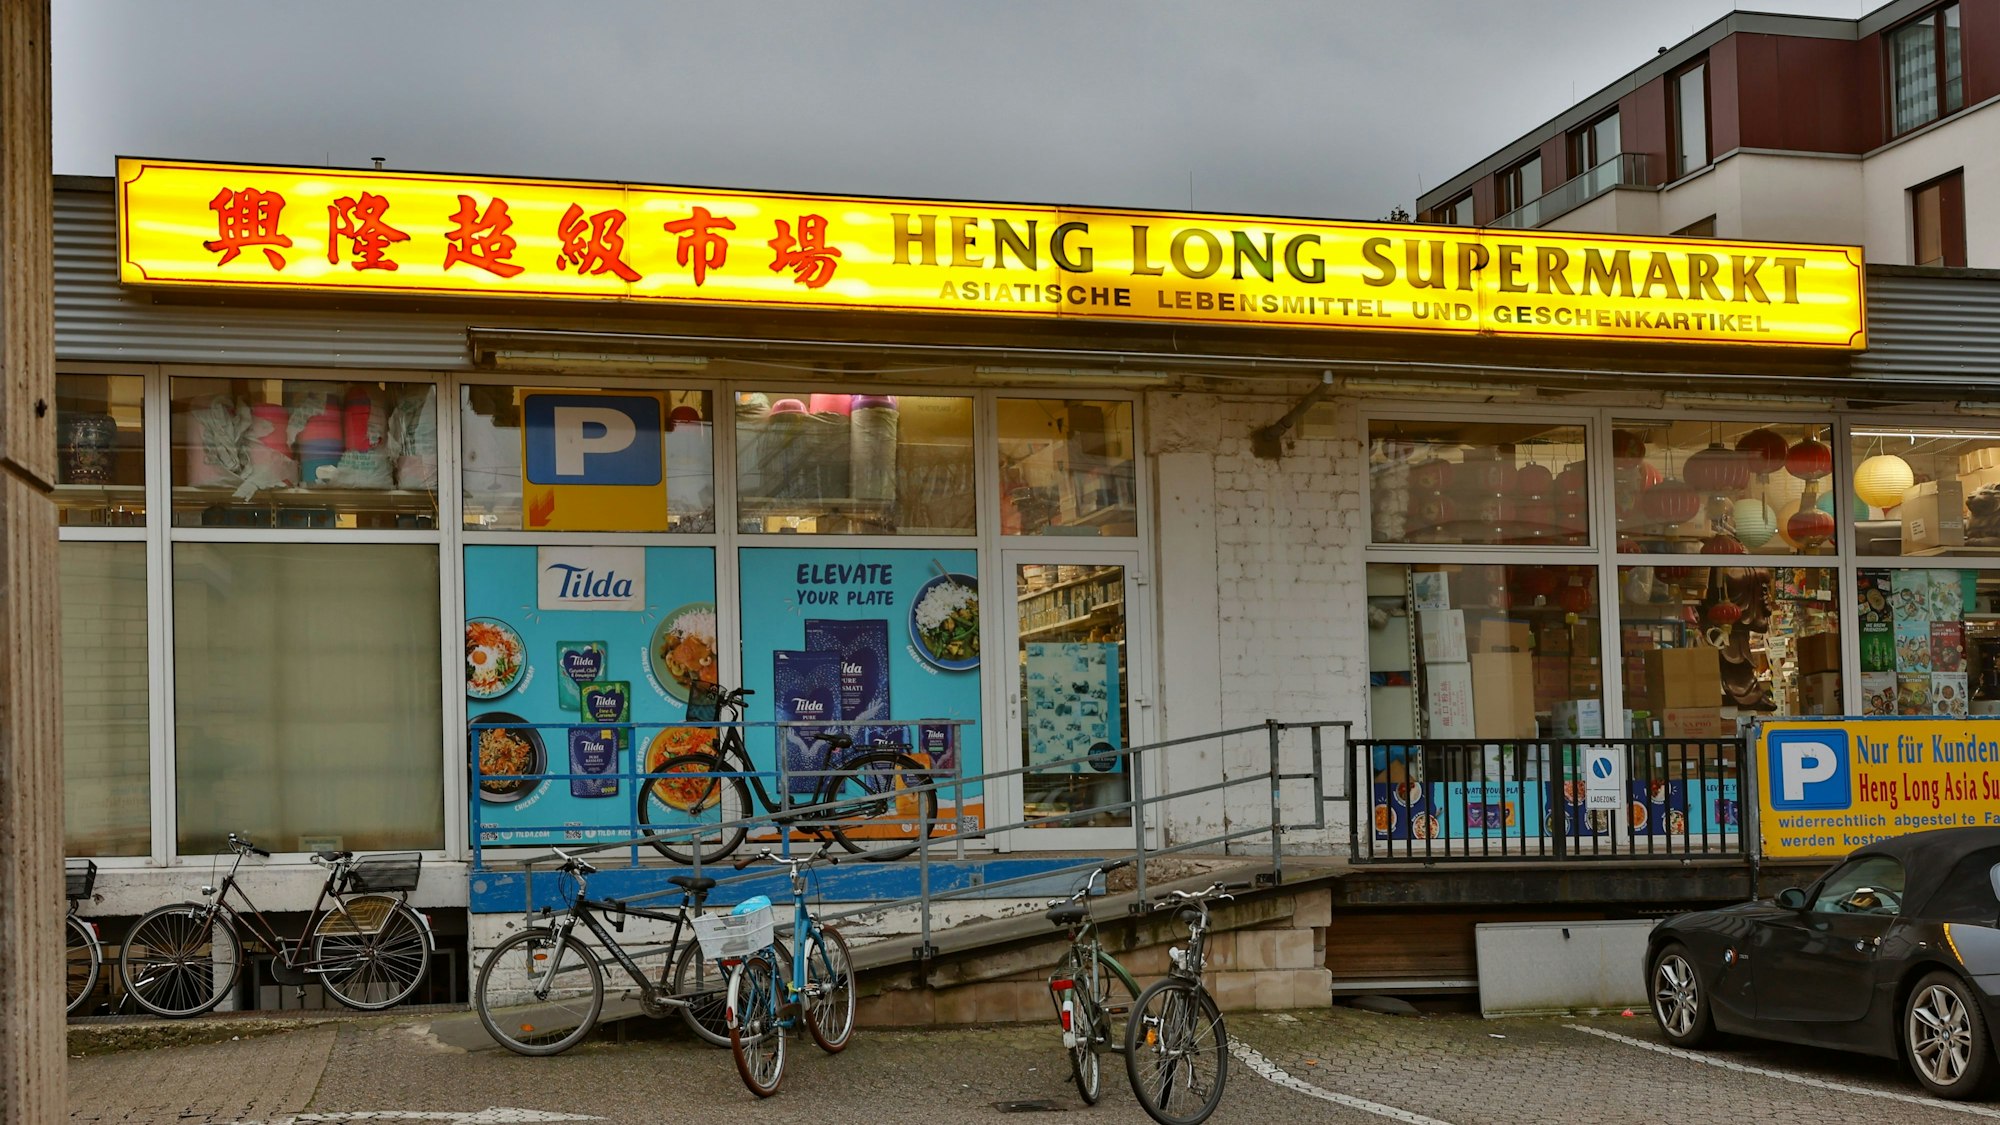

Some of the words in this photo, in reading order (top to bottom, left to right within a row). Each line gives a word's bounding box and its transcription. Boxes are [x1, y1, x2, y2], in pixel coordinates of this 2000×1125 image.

[203, 187, 842, 289] 興隆超級市場
[890, 212, 1094, 273] HENG
[1129, 224, 1326, 284] LONG
[1361, 236, 1806, 305] SUPERMARKT
[938, 280, 1131, 308] ASIATISCHE
[1158, 289, 1391, 318] LEBENSMITTEL
[1411, 301, 1472, 323] UND
[1493, 305, 1770, 333] GESCHENKARTIKEL
[553, 406, 637, 476] P
[546, 563, 633, 598] Tilda
[796, 563, 893, 585] ELEVATE
[796, 590, 839, 606] YOUR
[847, 590, 894, 606] PLATE
[570, 655, 594, 666] Tilda
[841, 661, 862, 674] lda
[905, 644, 922, 666] GREEN
[919, 661, 938, 677] CURRY
[592, 695, 616, 706] Tilda
[791, 697, 824, 712] Tilda
[925, 729, 944, 739] Tilda
[580, 740, 605, 752] Tilda
[1856, 735, 1889, 764] Nur
[1897, 734, 1924, 764] für
[1931, 733, 1999, 763] Kunden
[1780, 742, 1838, 801] P
[1590, 795, 1617, 803] LADEZONE
[1859, 773, 1898, 810] Heng
[1903, 772, 1939, 810] Long
[1944, 771, 1978, 801] Asia
[514, 794, 540, 812] CHICKEN
[1778, 814, 1886, 828] widerrechtlich
[1781, 834, 1836, 847] werden
